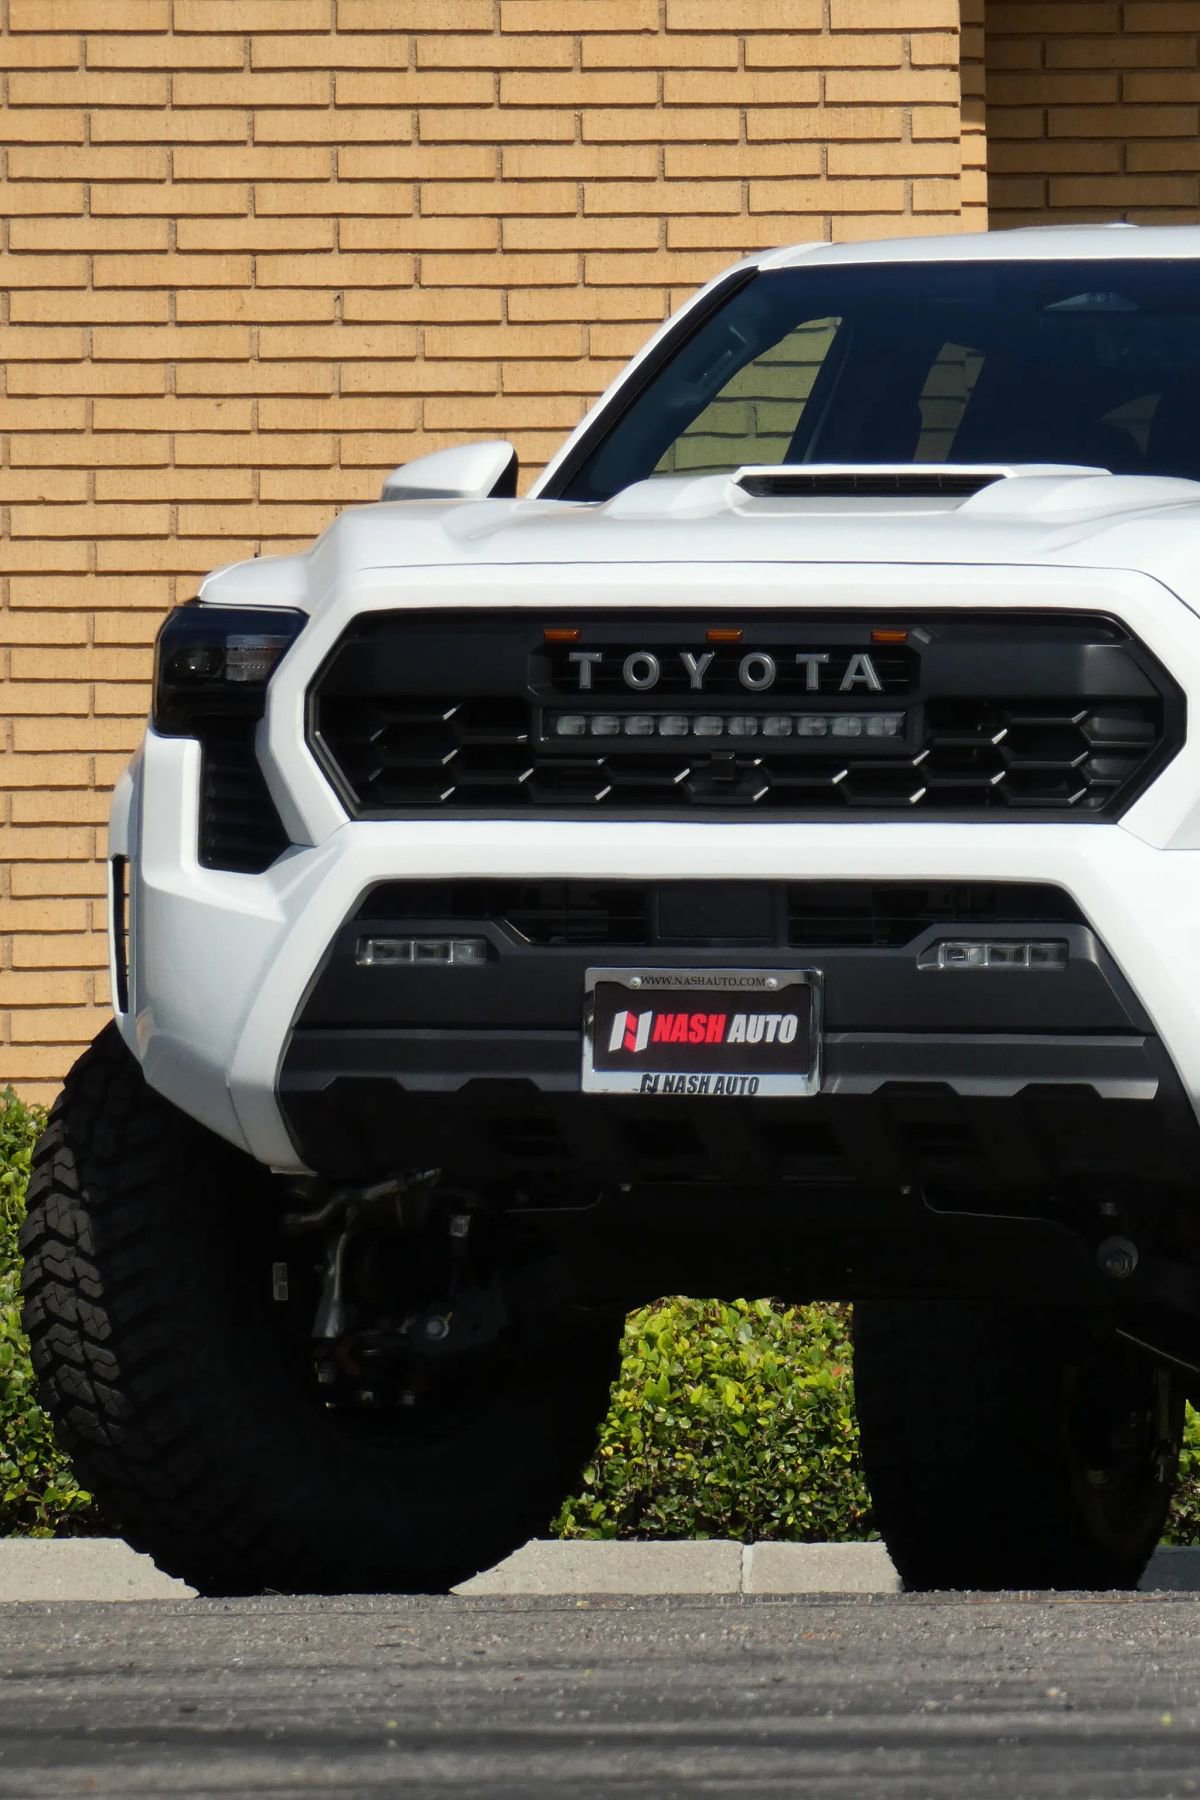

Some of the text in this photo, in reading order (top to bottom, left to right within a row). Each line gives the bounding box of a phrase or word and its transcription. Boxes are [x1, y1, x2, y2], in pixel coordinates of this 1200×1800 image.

[569, 652, 882, 690] TOYOTA
[640, 976, 765, 987] WWW.NASHAUTO.COM
[653, 1013, 727, 1043] NASH
[727, 1014, 798, 1043] AUTO
[662, 1074, 711, 1094] NASH
[713, 1075, 760, 1095] AUTO
